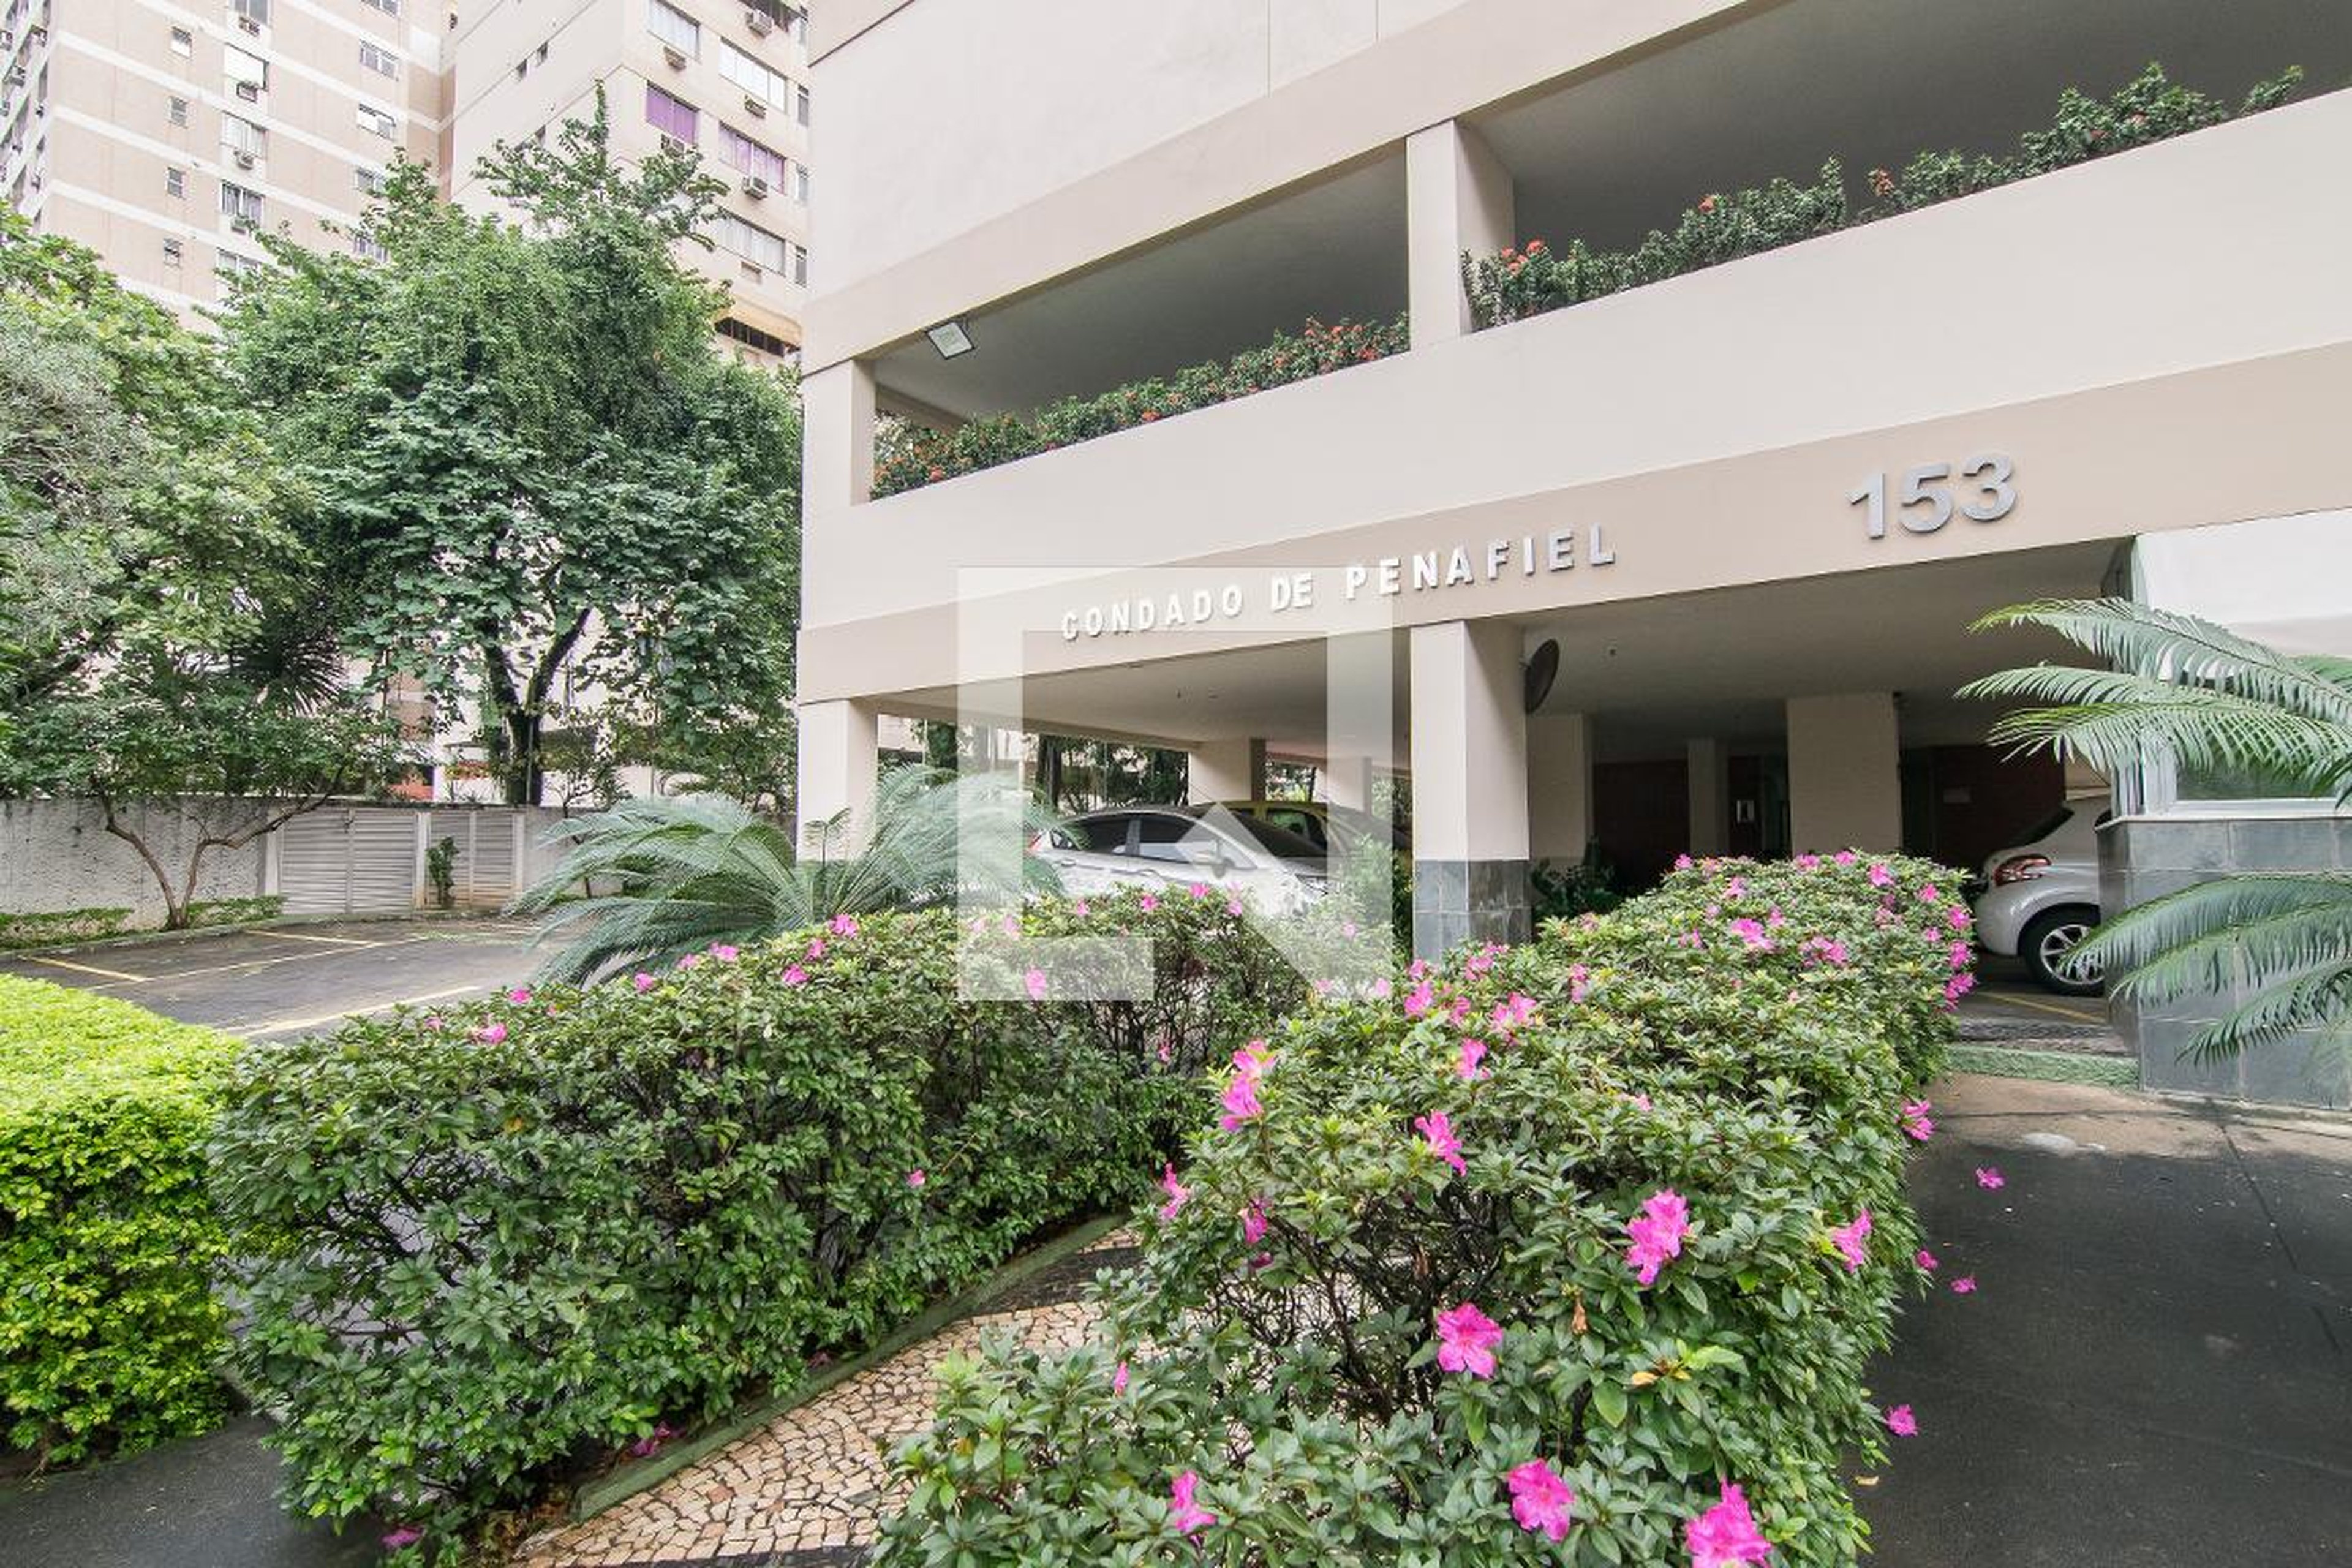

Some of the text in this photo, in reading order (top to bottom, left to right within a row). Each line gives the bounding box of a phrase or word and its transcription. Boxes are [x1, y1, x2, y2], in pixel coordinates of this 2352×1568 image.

[1847, 453, 2017, 540] 153
[1061, 522, 1616, 641] CONDADO DE PENAFIEL
